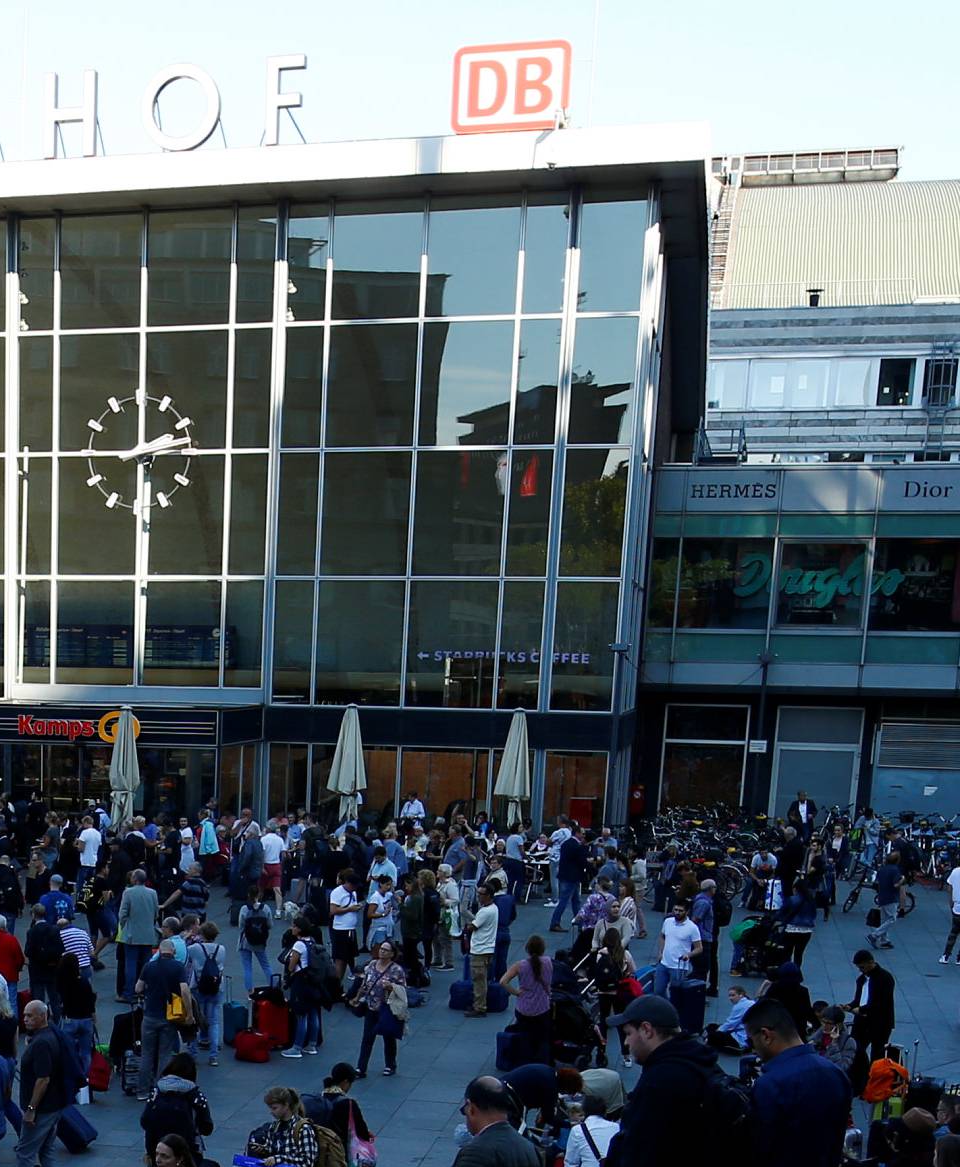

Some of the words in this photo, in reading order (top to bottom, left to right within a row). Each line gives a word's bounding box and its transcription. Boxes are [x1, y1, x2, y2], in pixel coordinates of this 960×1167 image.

[468, 57, 554, 117] DB
[903, 480, 953, 497] Dior
[530, 651, 590, 664] CFFEE
[17, 714, 95, 741] Kamps
